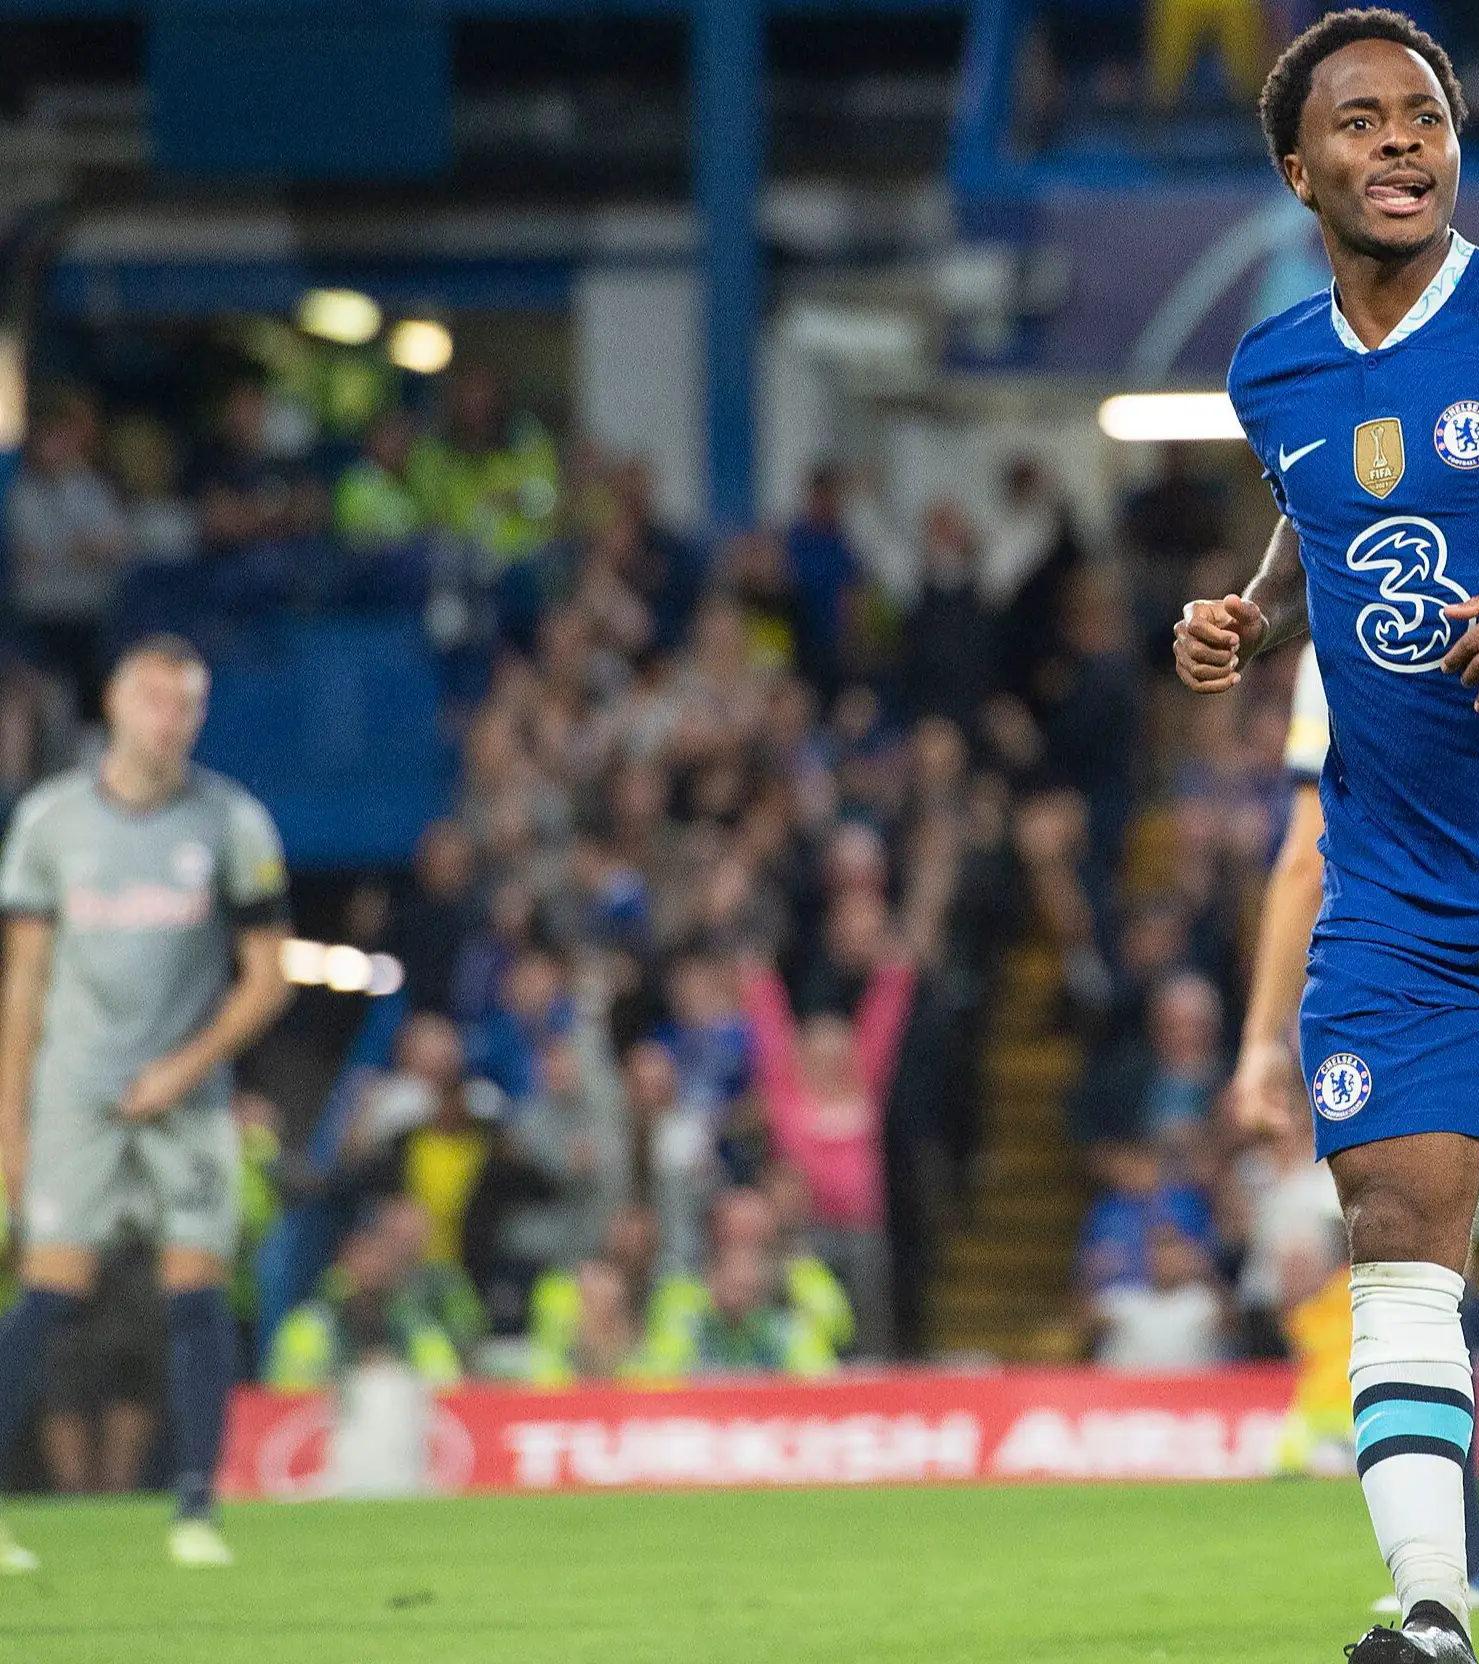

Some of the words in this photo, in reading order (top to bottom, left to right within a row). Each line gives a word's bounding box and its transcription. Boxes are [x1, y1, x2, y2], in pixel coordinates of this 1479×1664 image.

[1369, 466, 1393, 480] FIFA
[1320, 1055, 1358, 1075] CHELSEA
[508, 1410, 981, 1487] TURKISH
